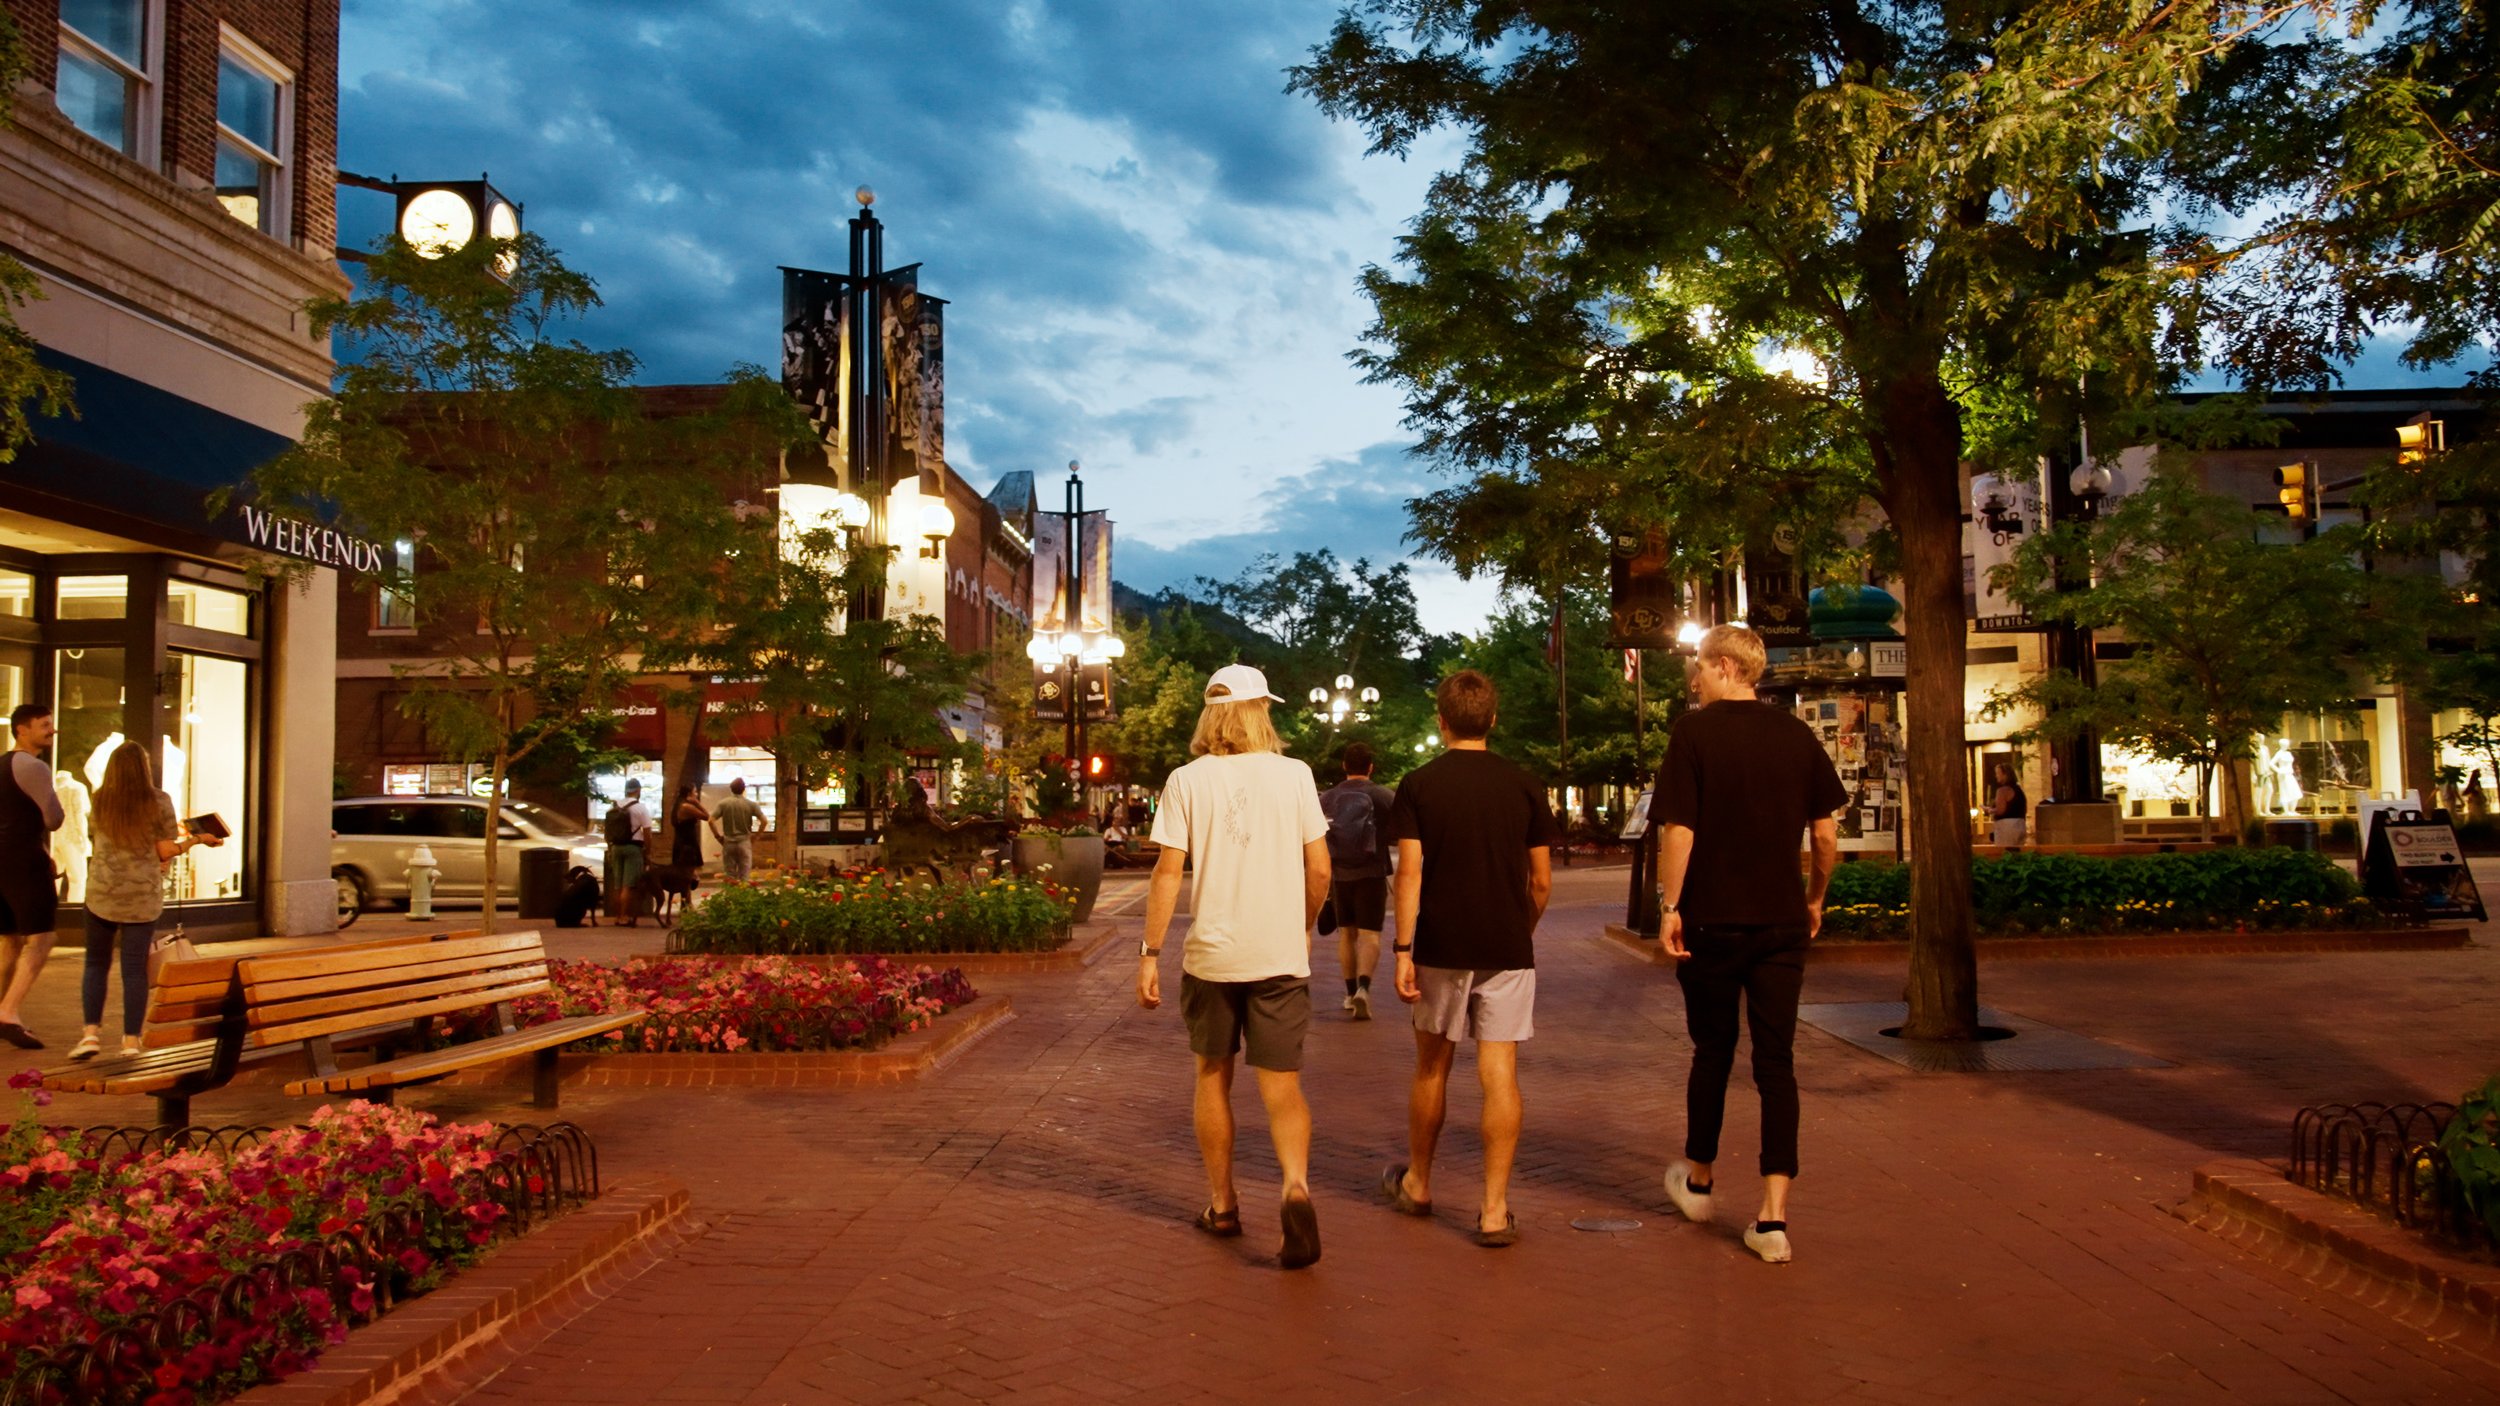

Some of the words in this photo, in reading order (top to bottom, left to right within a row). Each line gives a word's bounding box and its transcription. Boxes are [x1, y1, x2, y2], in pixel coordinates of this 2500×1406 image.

[244, 505, 382, 574] WEEKENDS
[1993, 533, 2015, 547] OF
[1982, 616, 2031, 629] DOWNTO
